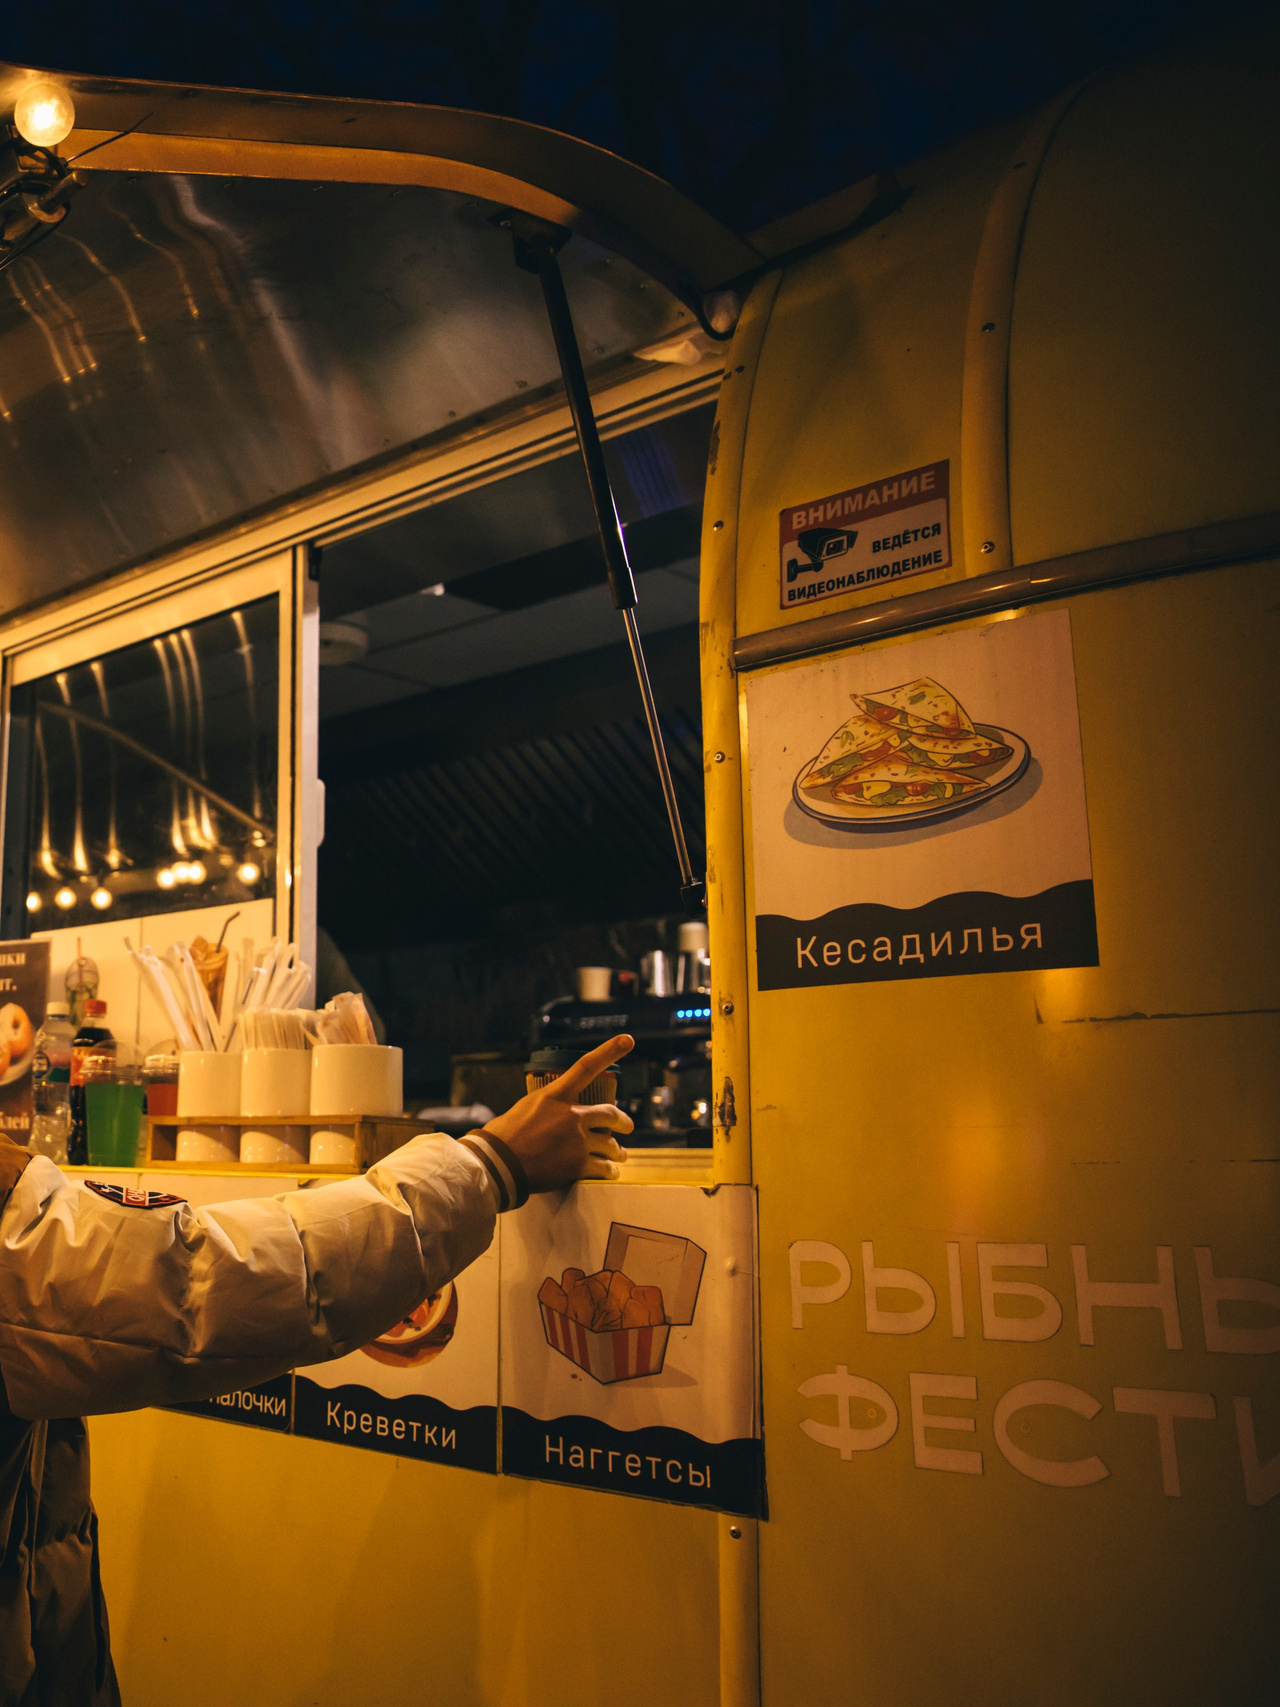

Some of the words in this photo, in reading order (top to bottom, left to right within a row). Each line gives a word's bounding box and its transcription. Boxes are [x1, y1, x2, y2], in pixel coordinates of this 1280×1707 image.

[792, 471, 936, 530] ВНИМАНИЕ
[871, 523, 941, 554] ВЕДЁТСЯ
[787, 550, 943, 602] ВИДЕОНАБЛЮДЕНИЕ
[796, 922, 1043, 969] Кесадилья
[326, 1400, 456, 1450] Креветки
[545, 1434, 711, 1489] Наггетсы
